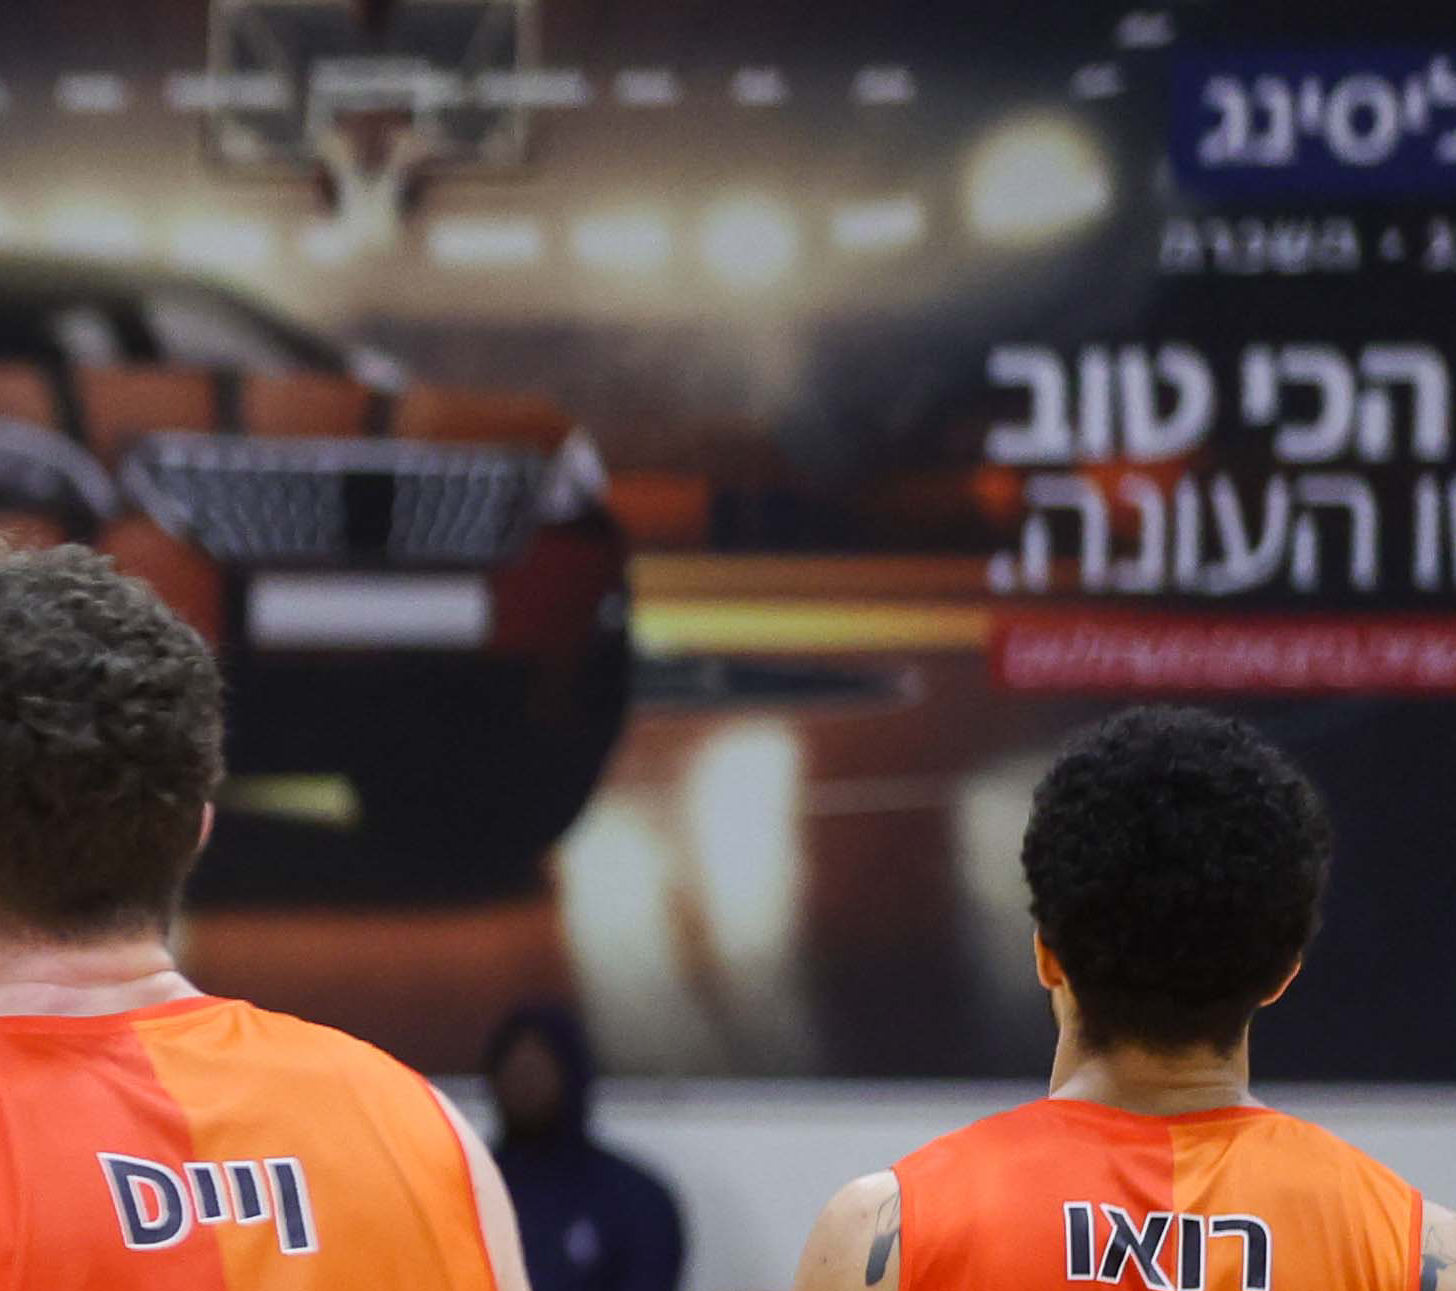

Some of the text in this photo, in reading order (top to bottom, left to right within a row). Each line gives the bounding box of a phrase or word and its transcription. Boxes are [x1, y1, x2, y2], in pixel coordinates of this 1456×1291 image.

[986, 342, 1450, 464] הכי טוב
[987, 470, 1381, 596] העונה.
[96, 1151, 318, 1255] וייס
